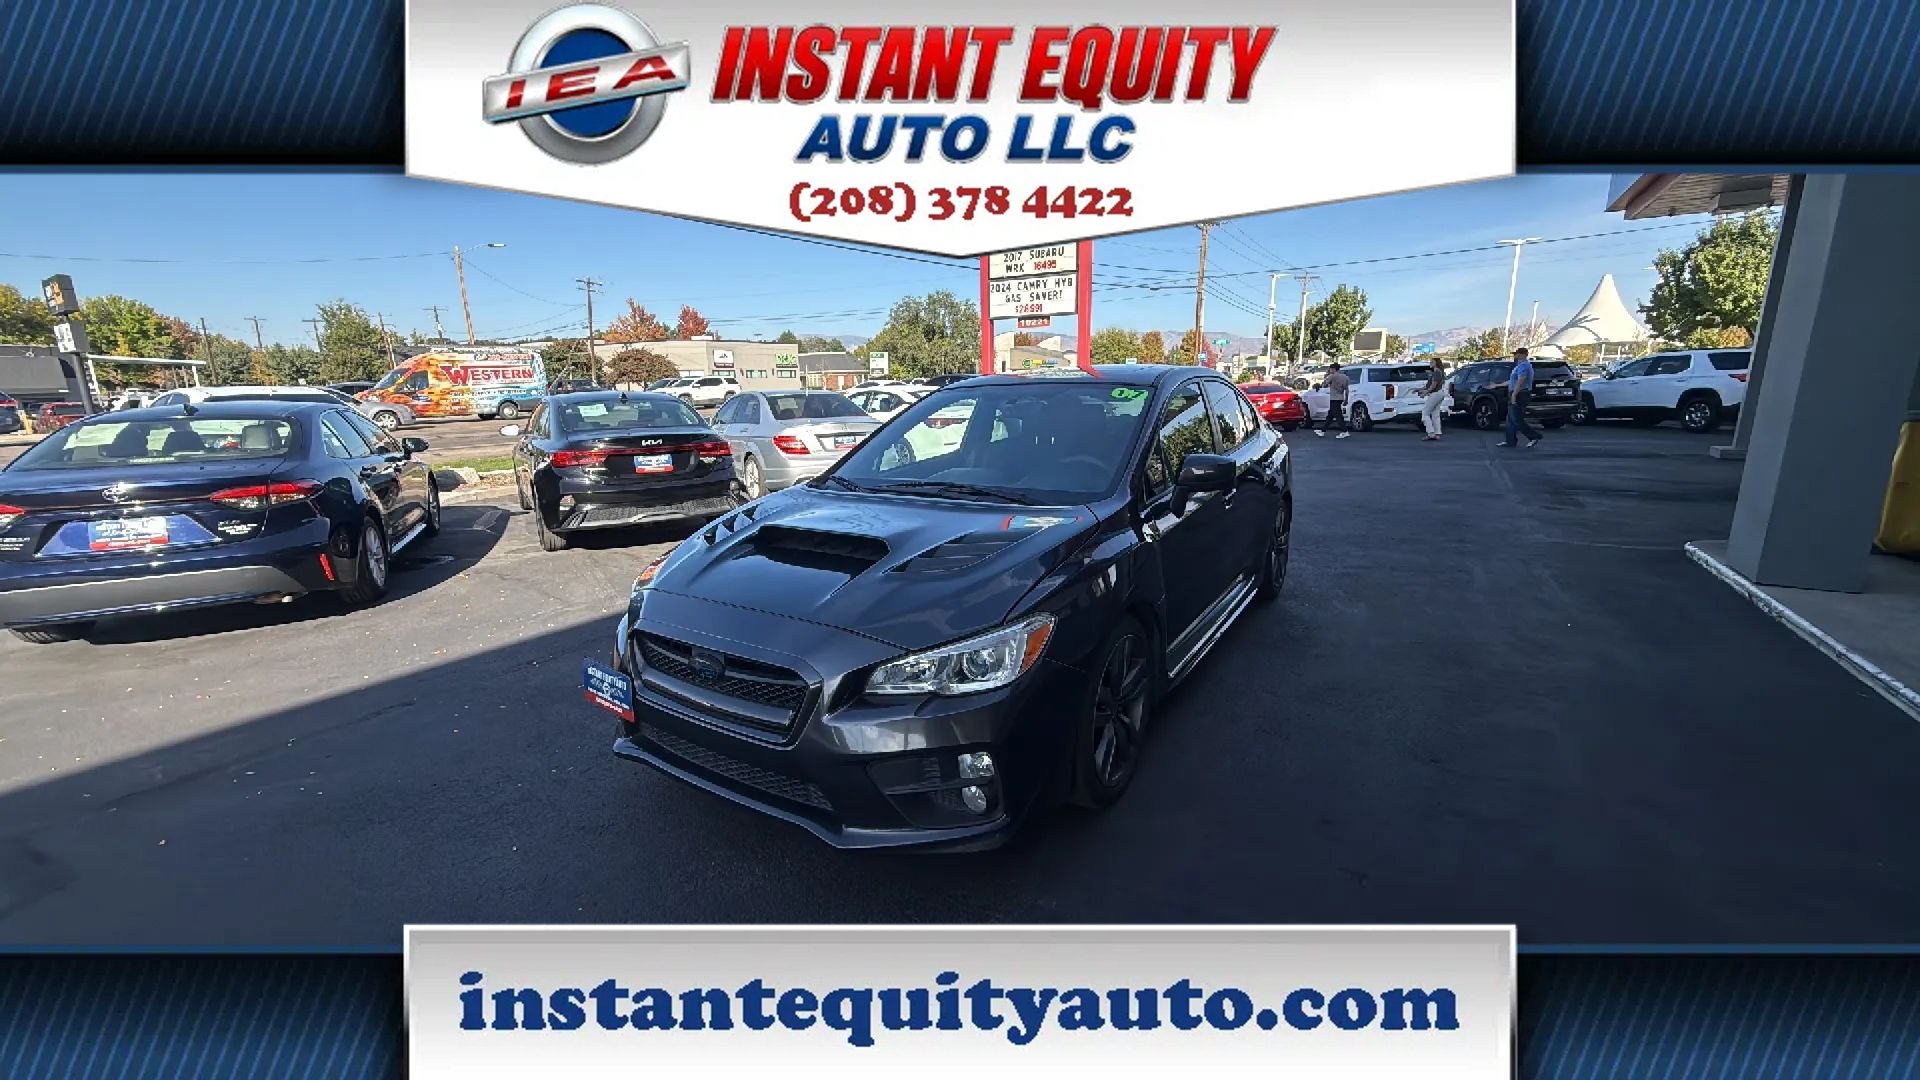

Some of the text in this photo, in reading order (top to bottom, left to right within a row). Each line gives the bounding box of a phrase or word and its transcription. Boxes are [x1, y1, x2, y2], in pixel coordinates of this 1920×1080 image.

[1003, 246, 1065, 263] 2017 SUBARU
[1005, 262, 1025, 273] WRX
[990, 282, 1011, 293] 2024
[1017, 278, 1048, 291] CAMRY
[1005, 293, 1021, 303] GAS
[440, 365, 536, 385] WESTERN
